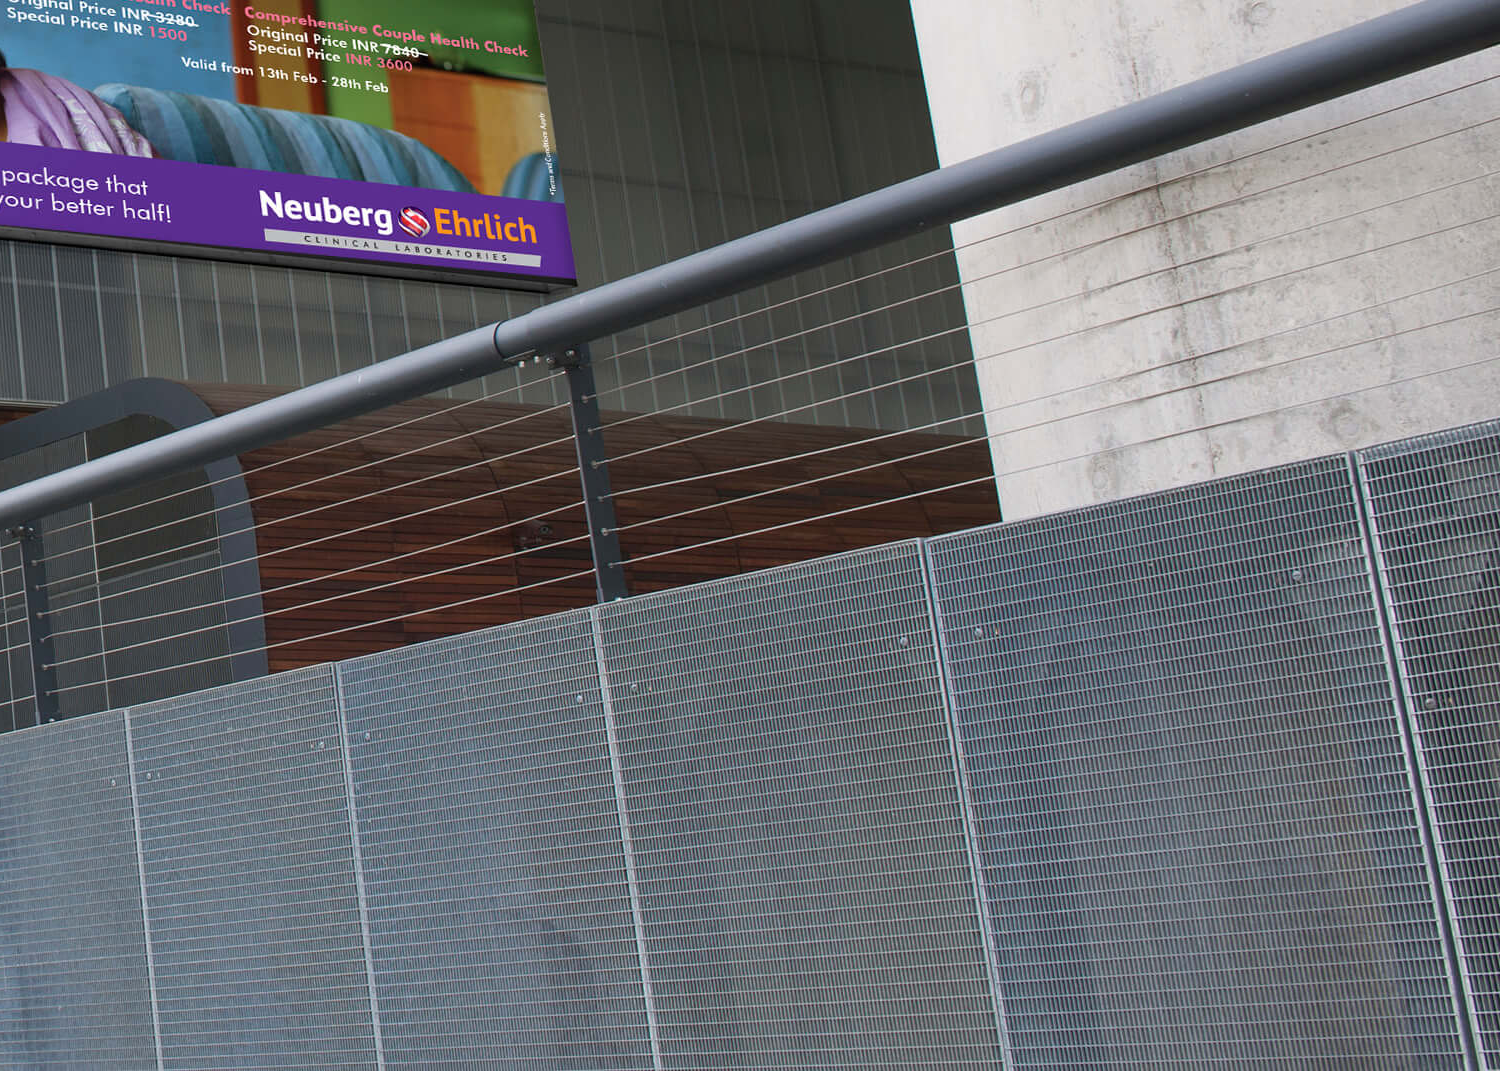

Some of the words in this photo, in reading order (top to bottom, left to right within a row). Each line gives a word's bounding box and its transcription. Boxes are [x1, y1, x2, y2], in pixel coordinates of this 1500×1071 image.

[6, 6, 65, 26] Special
[71, 15, 108, 32] Price
[113, 21, 143, 36] INR
[148, 26, 188, 42] 1500
[79, 1, 116, 17] Price
[122, 7, 149, 21] INR
[244, 6, 368, 34] Comprehensive
[372, 25, 425, 44] Couple
[430, 32, 480, 51] Health
[484, 40, 529, 58] Check
[247, 25, 309, 45] Original
[313, 34, 348, 49] Price
[352, 39, 379, 53] INR
[248, 39, 301, 57] Special
[307, 49, 341, 63] Price
[345, 53, 372, 66] INR
[377, 58, 413, 72] 3600
[181, 56, 217, 72] Valid
[221, 61, 254, 76] from
[258, 66, 289, 81] 13th
[293, 70, 318, 84] Feb
[331, 76, 361, 90] 28th
[365, 80, 389, 93] Feb
[2, 167, 99, 194] package
[106, 175, 148, 196] that
[52, 193, 114, 217] better
[123, 200, 172, 223] half!
[259, 190, 393, 236] Neuberg
[434, 207, 537, 244] Ehrlich
[304, 234, 379, 250] CLINICAL
[394, 243, 508, 262] LABORATORIES
